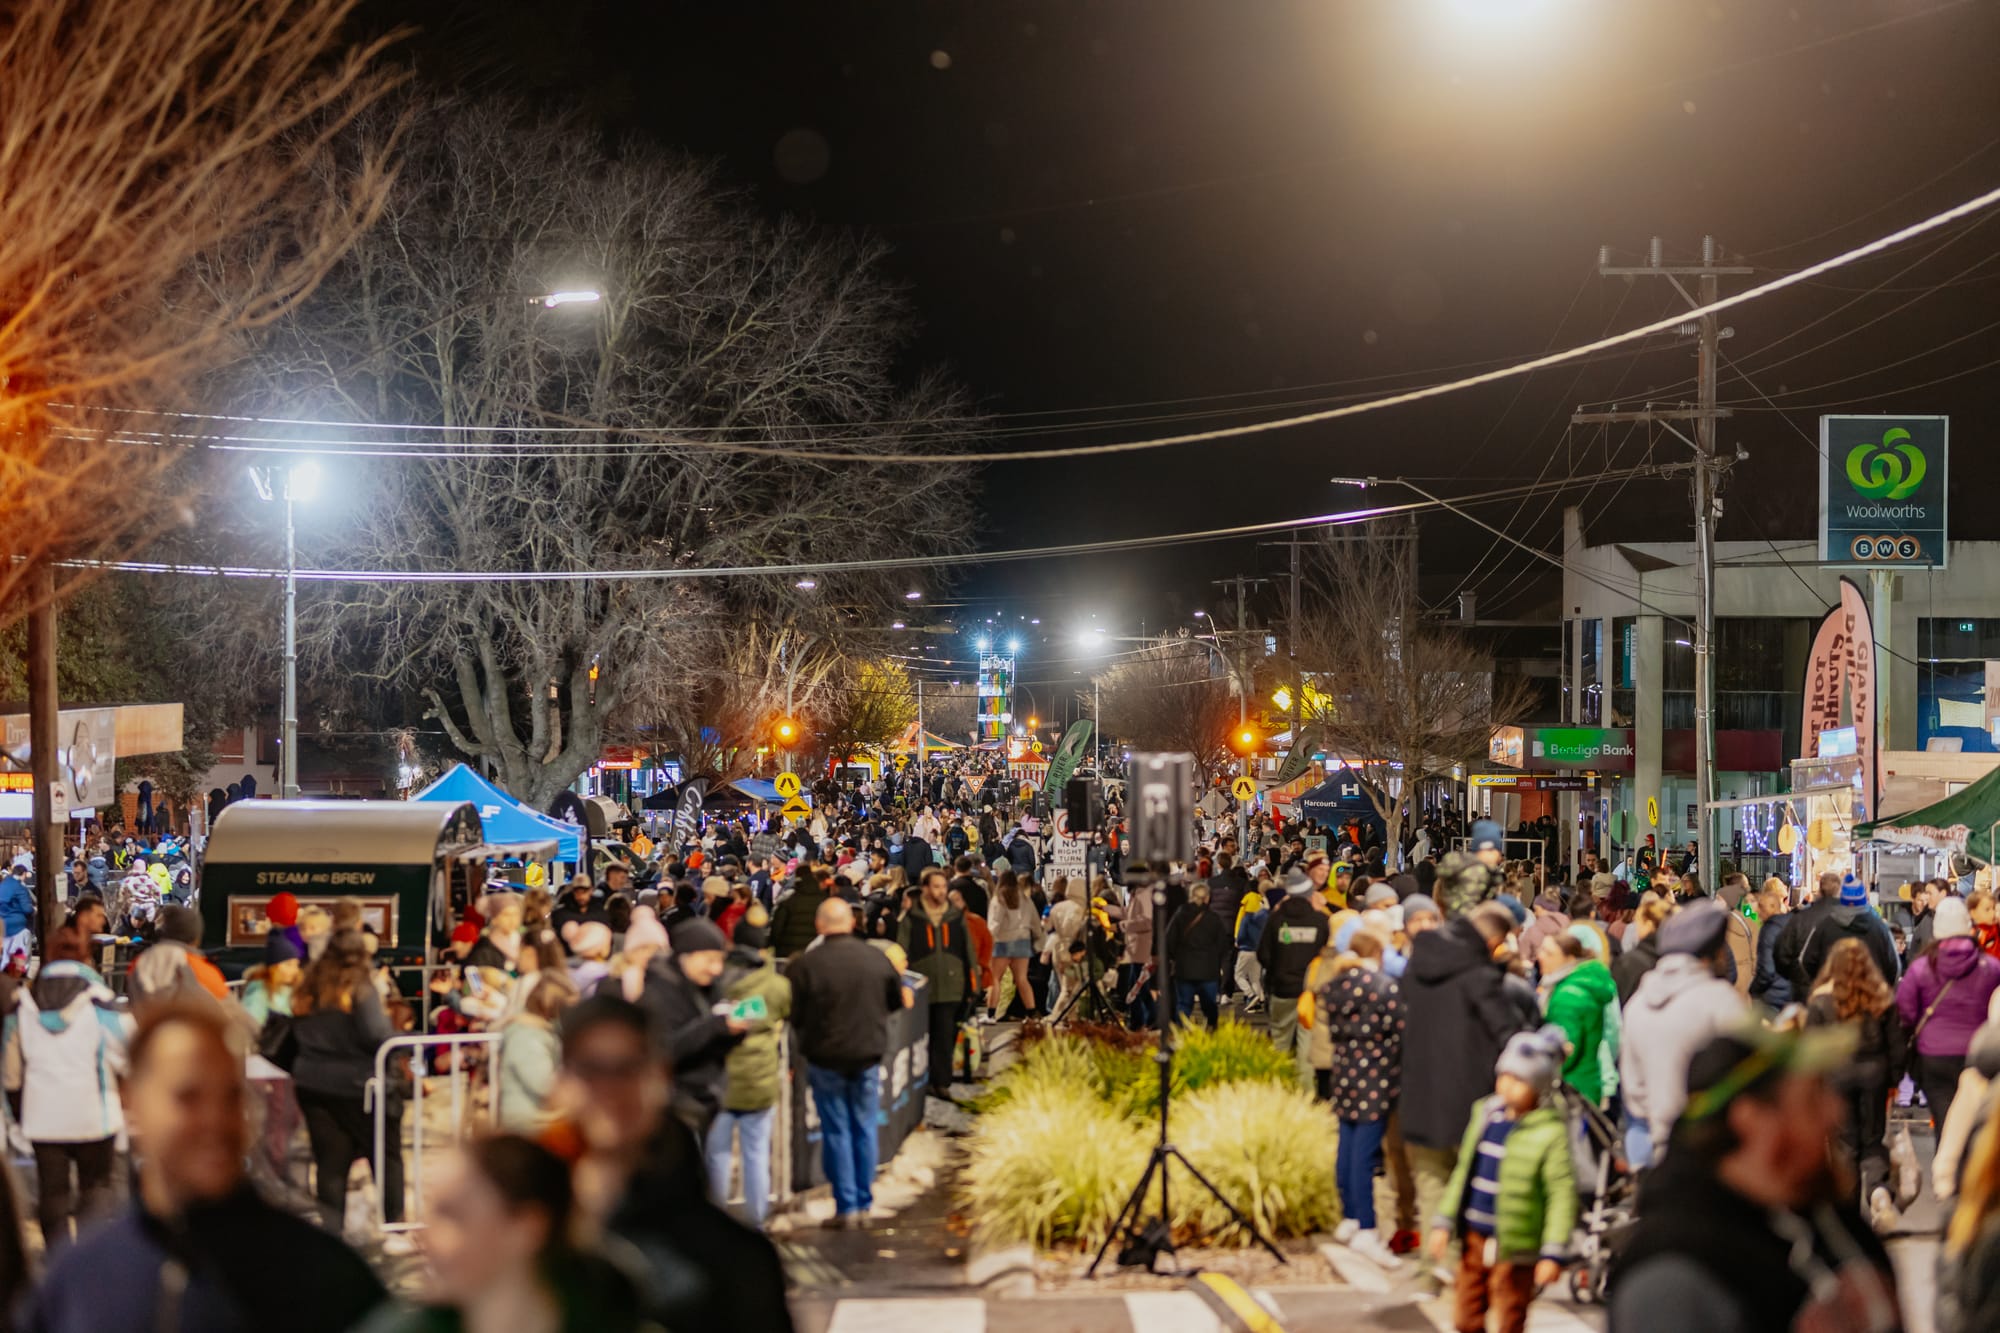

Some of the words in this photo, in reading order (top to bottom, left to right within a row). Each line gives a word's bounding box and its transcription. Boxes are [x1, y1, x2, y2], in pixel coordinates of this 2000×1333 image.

[1846, 503, 1926, 519] Woolworths
[1812, 656, 1827, 713] HOT
[1823, 633, 1845, 730] GHNUTS
[1855, 640, 1869, 723] GIANT
[1550, 743, 1600, 758] Bendigo
[1602, 744, 1634, 756] Bank
[1304, 799, 1338, 808] Harcourts
[673, 786, 703, 853] Coffee
[1062, 839, 1078, 848] NO
[256, 871, 310, 885] STEAM
[330, 871, 376, 885] BREW
